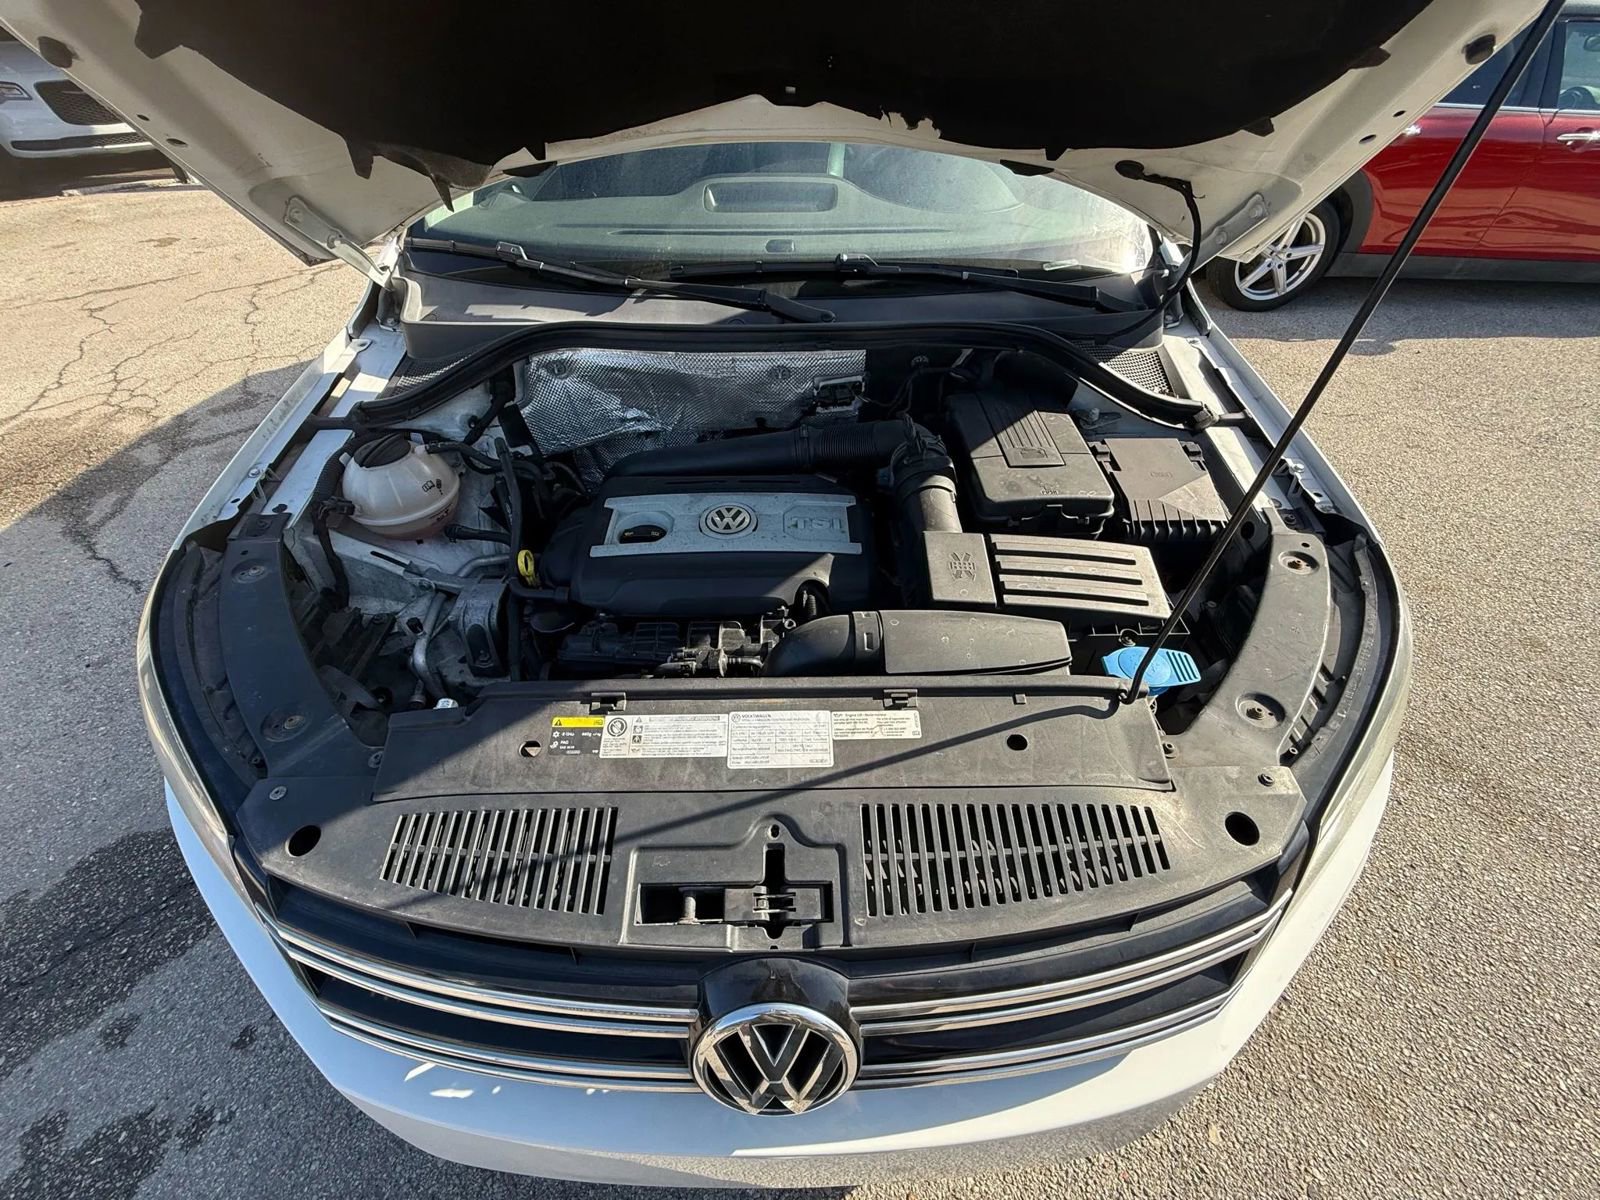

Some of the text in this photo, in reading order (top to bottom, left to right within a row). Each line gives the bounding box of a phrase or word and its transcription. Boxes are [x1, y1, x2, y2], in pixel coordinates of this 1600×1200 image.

[707, 504, 751, 534] VW
[791, 516, 842, 530] TSI
[701, 1018, 848, 1115] VW
